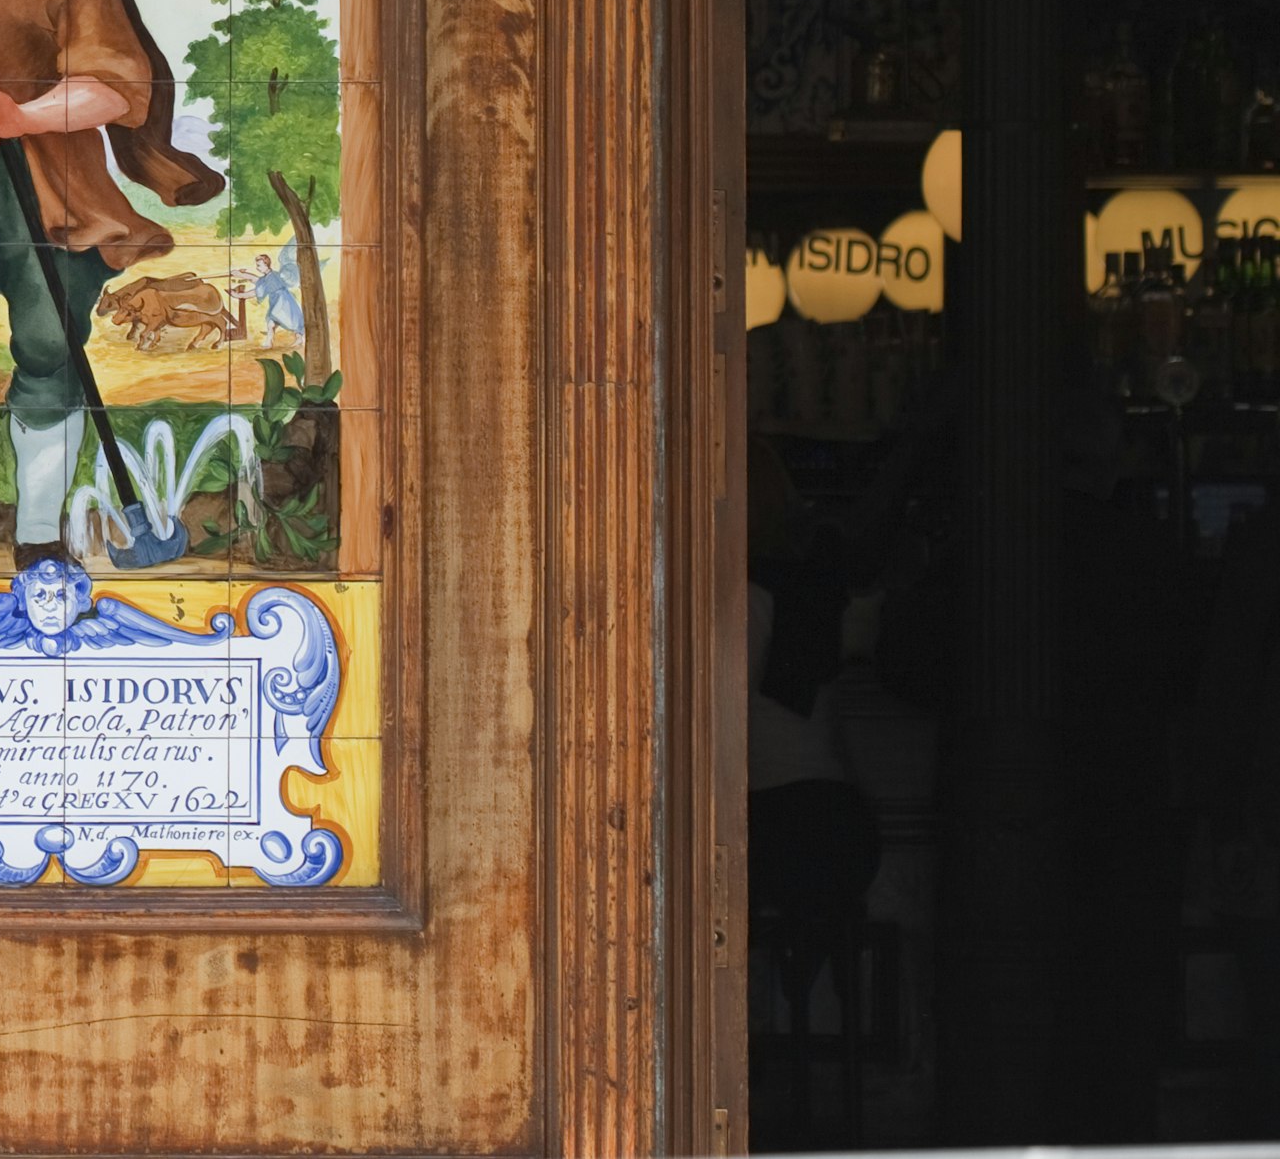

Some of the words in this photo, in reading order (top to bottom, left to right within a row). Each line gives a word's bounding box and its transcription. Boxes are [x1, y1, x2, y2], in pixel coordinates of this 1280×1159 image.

[797, 236, 932, 283] ISIDRO
[66, 677, 244, 704] ISIDORVS
[19, 770, 79, 787] anno
[170, 786, 248, 813] 1622
[233, 829, 260, 841] ex.
